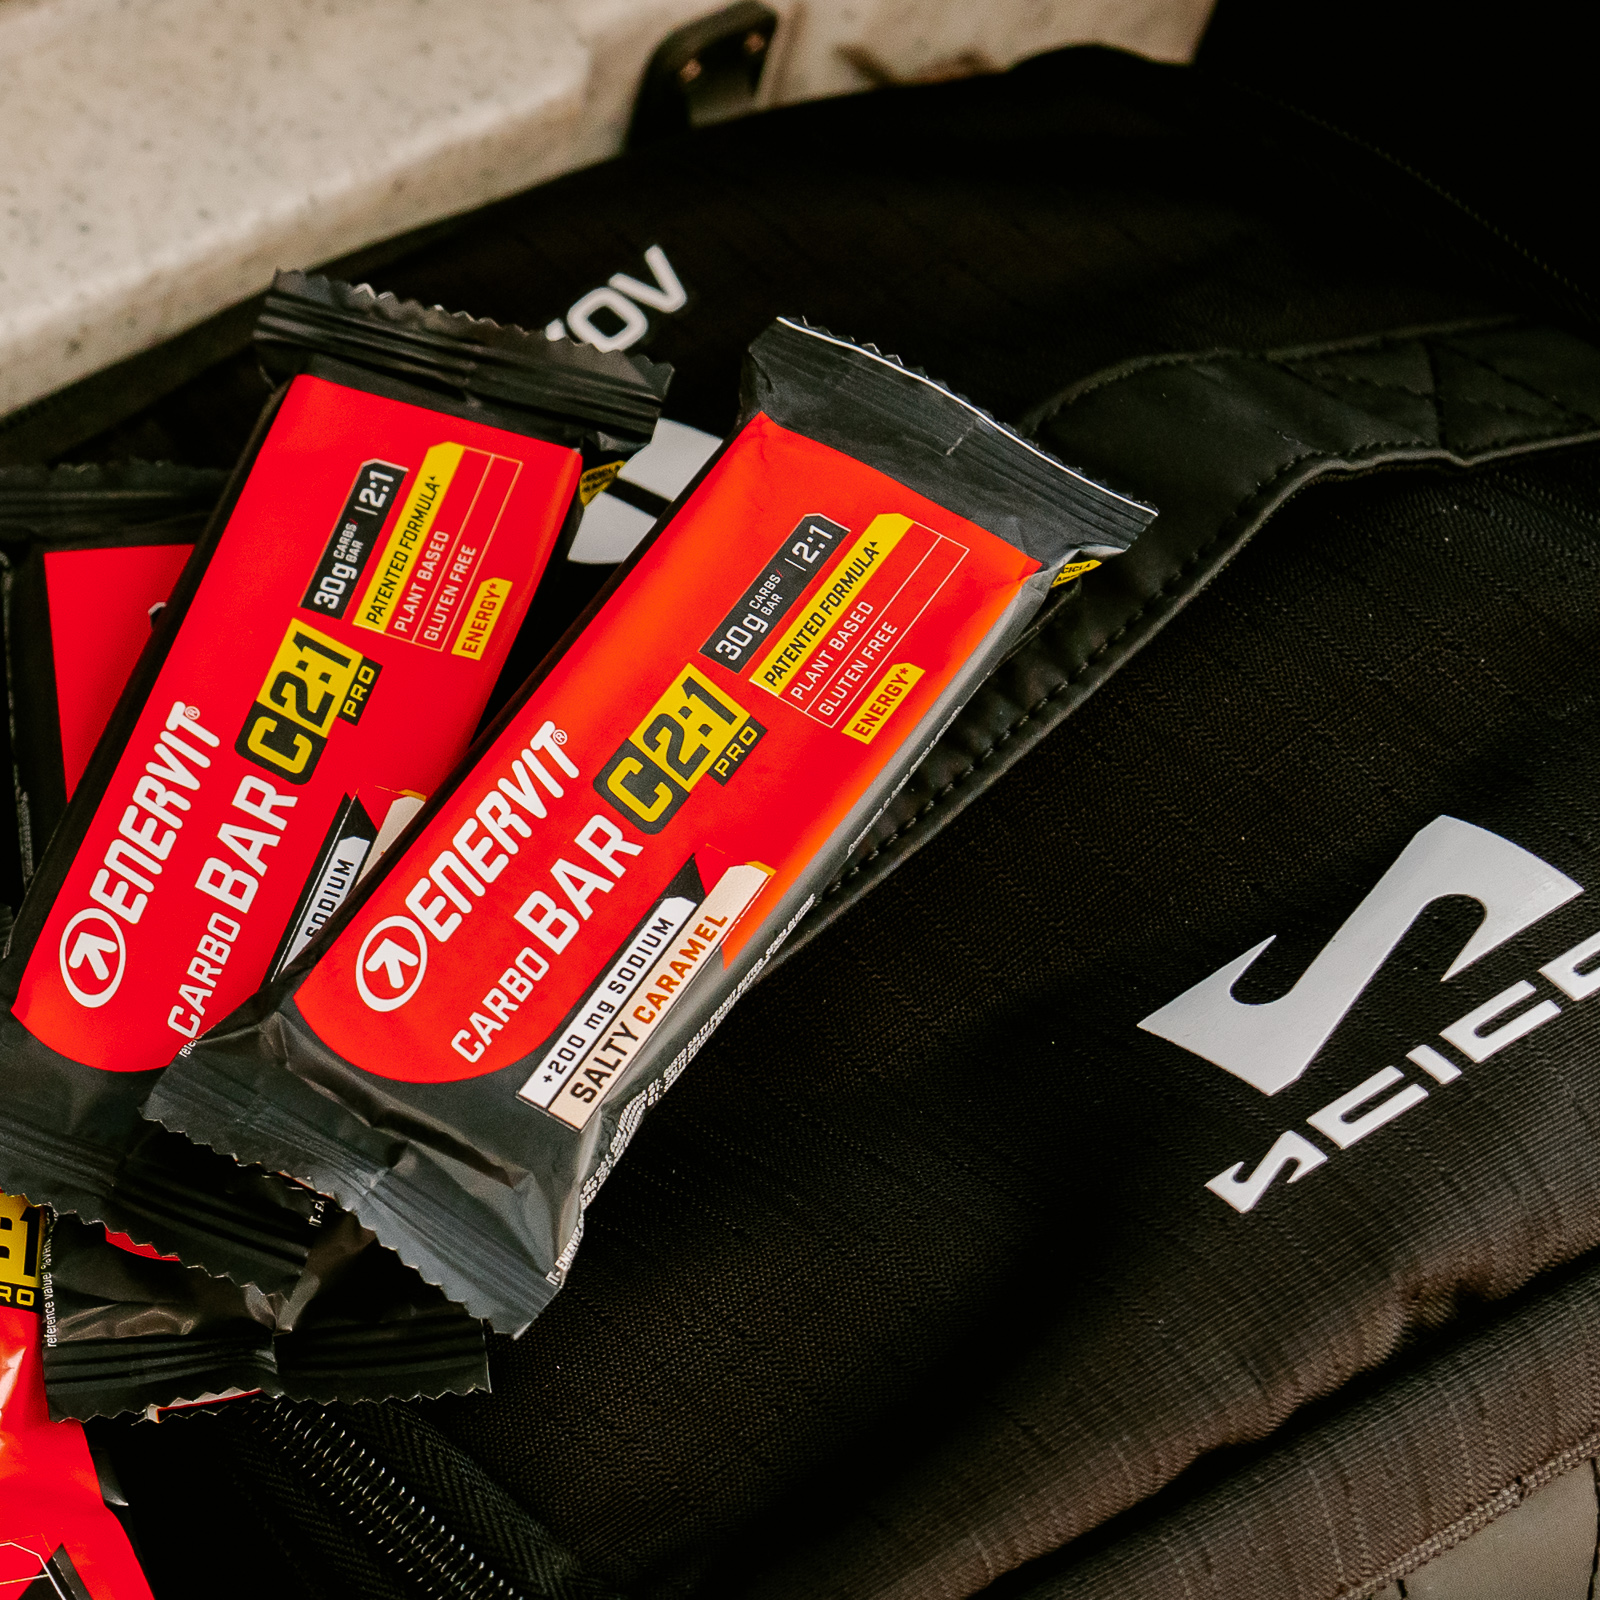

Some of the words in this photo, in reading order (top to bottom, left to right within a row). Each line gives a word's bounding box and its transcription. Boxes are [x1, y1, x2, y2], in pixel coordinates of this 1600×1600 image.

[545, 245, 687, 352] OV
[359, 470, 395, 508] 2:1
[345, 540, 363, 564] BAR
[394, 580, 426, 632] PLANT
[418, 531, 449, 581] BASED
[791, 523, 833, 564] 2:1
[314, 563, 358, 609] 30g
[366, 549, 408, 624] PATENTED
[424, 578, 459, 642] GLUTEN
[449, 544, 476, 585] FREE
[760, 592, 784, 616] BAR
[715, 613, 769, 661] 30g
[763, 613, 826, 688] PATENTED
[790, 648, 838, 701] PLANT
[828, 600, 875, 652] BASED
[818, 663, 870, 718] GLUTEN
[861, 621, 899, 670] FREE
[247, 631, 354, 774] C2:1
[342, 667, 375, 717] PRO
[714, 725, 758, 777] PRO
[194, 775, 298, 913] BAR
[450, 946, 550, 1063] CARBO
[513, 814, 644, 956] BAR
[606, 682, 737, 823] C2:1
[305, 858, 355, 938] SODIUM
[167, 912, 241, 1038] CARBO
[542, 1034, 587, 1084] +200
[584, 998, 615, 1031] mg
[609, 916, 675, 996] SODIUM
[570, 1022, 640, 1104] SALTY
[632, 911, 728, 1025] CARAMEL
[43, 1300, 58, 1347] reference
